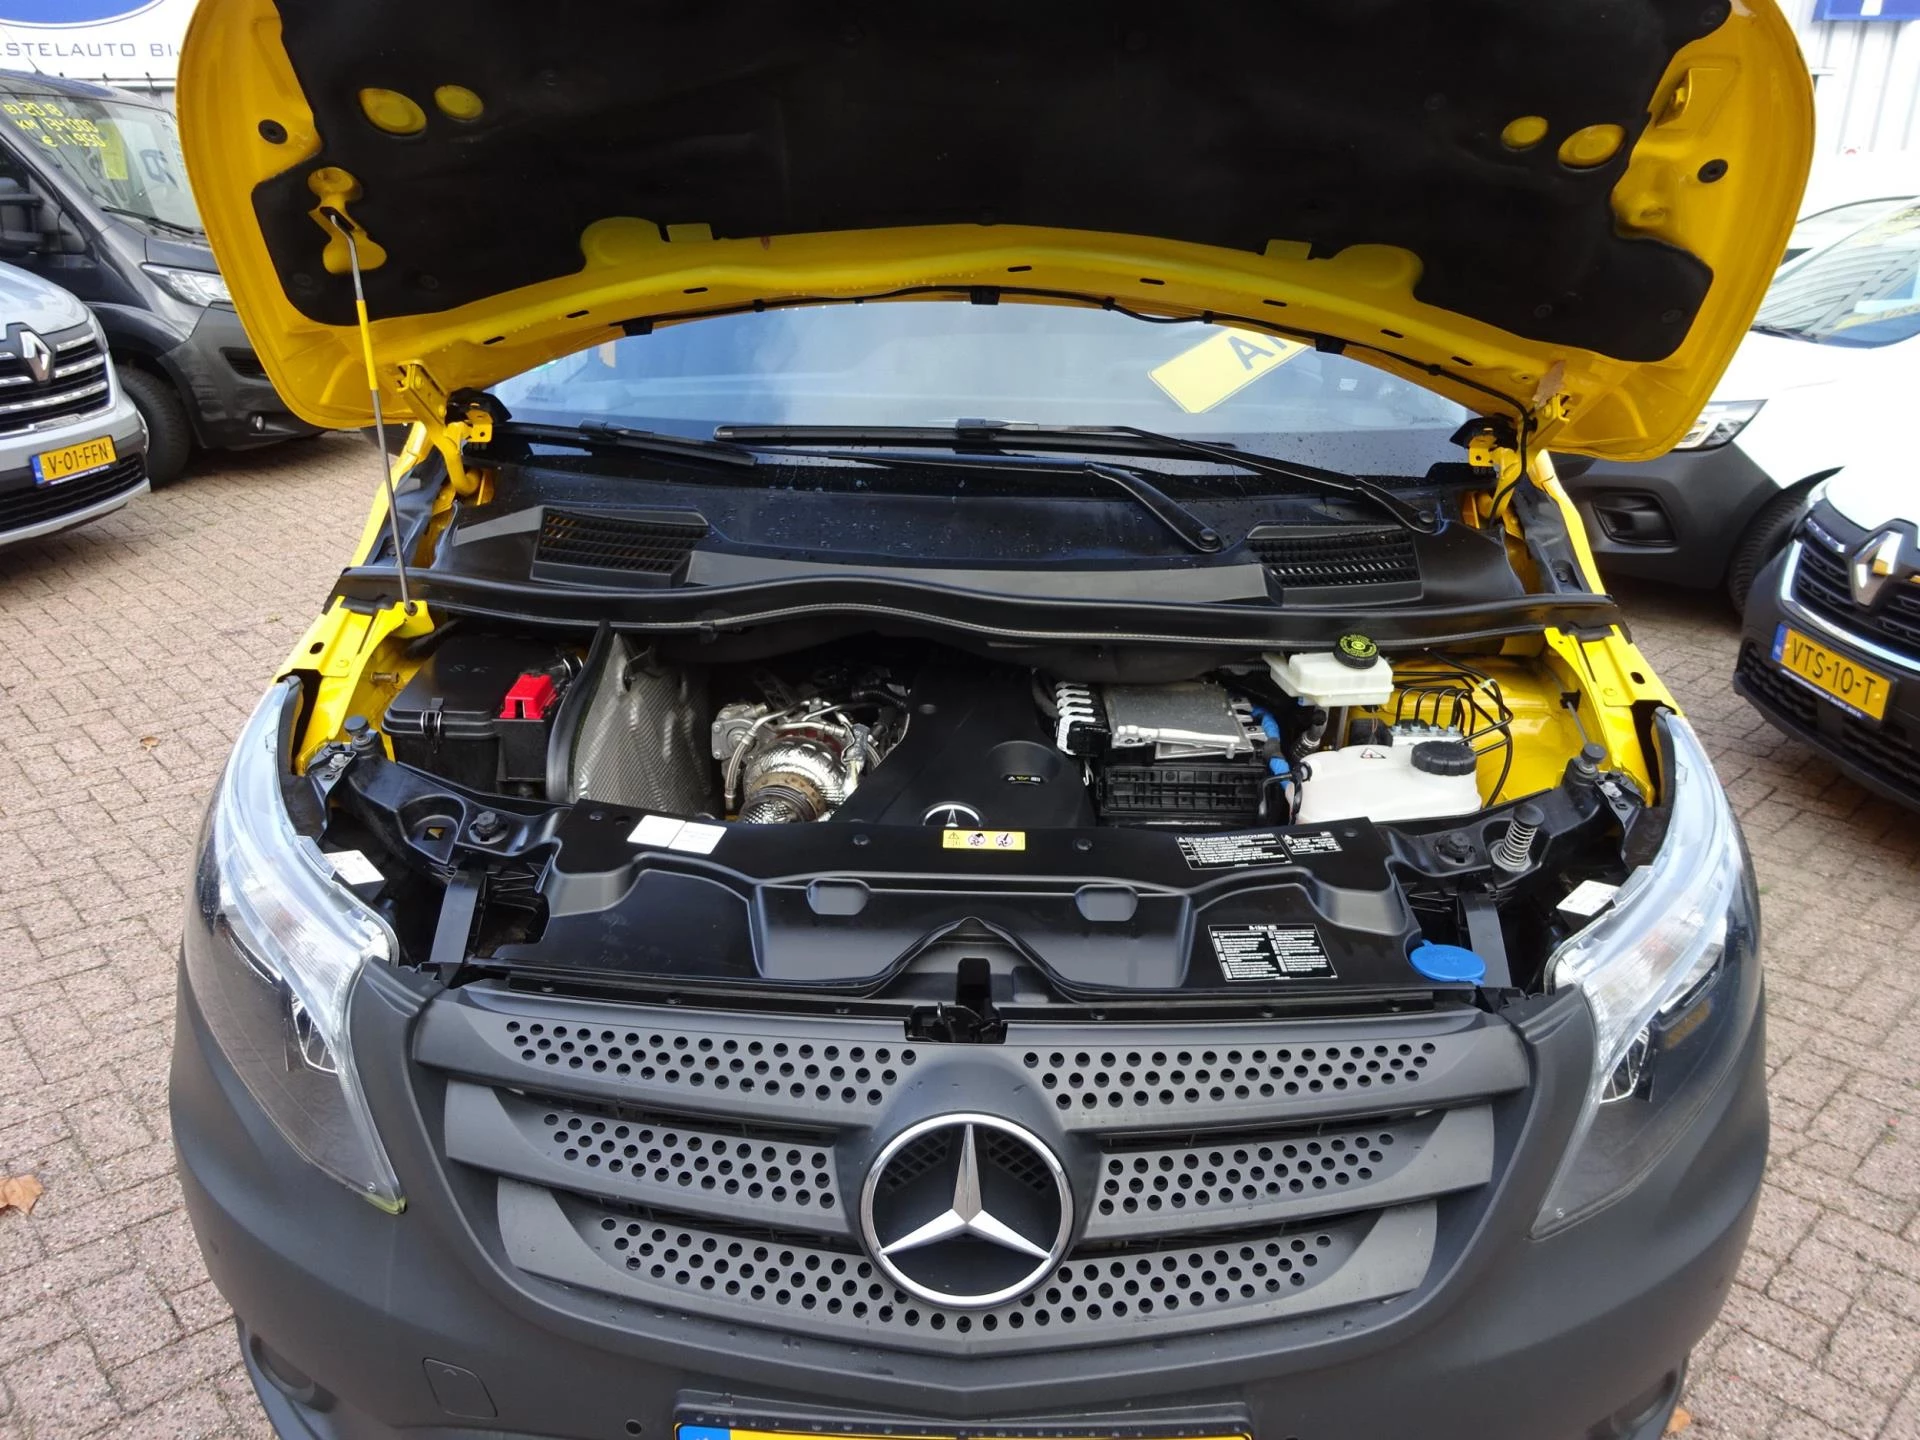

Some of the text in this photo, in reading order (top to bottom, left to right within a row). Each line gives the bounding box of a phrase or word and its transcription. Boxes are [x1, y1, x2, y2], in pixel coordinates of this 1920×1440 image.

[0, 42, 178, 57] STELAUTO BI
[47, 441, 109, 474] V-01-FFN
[1792, 637, 1876, 705] VTS-10-T
